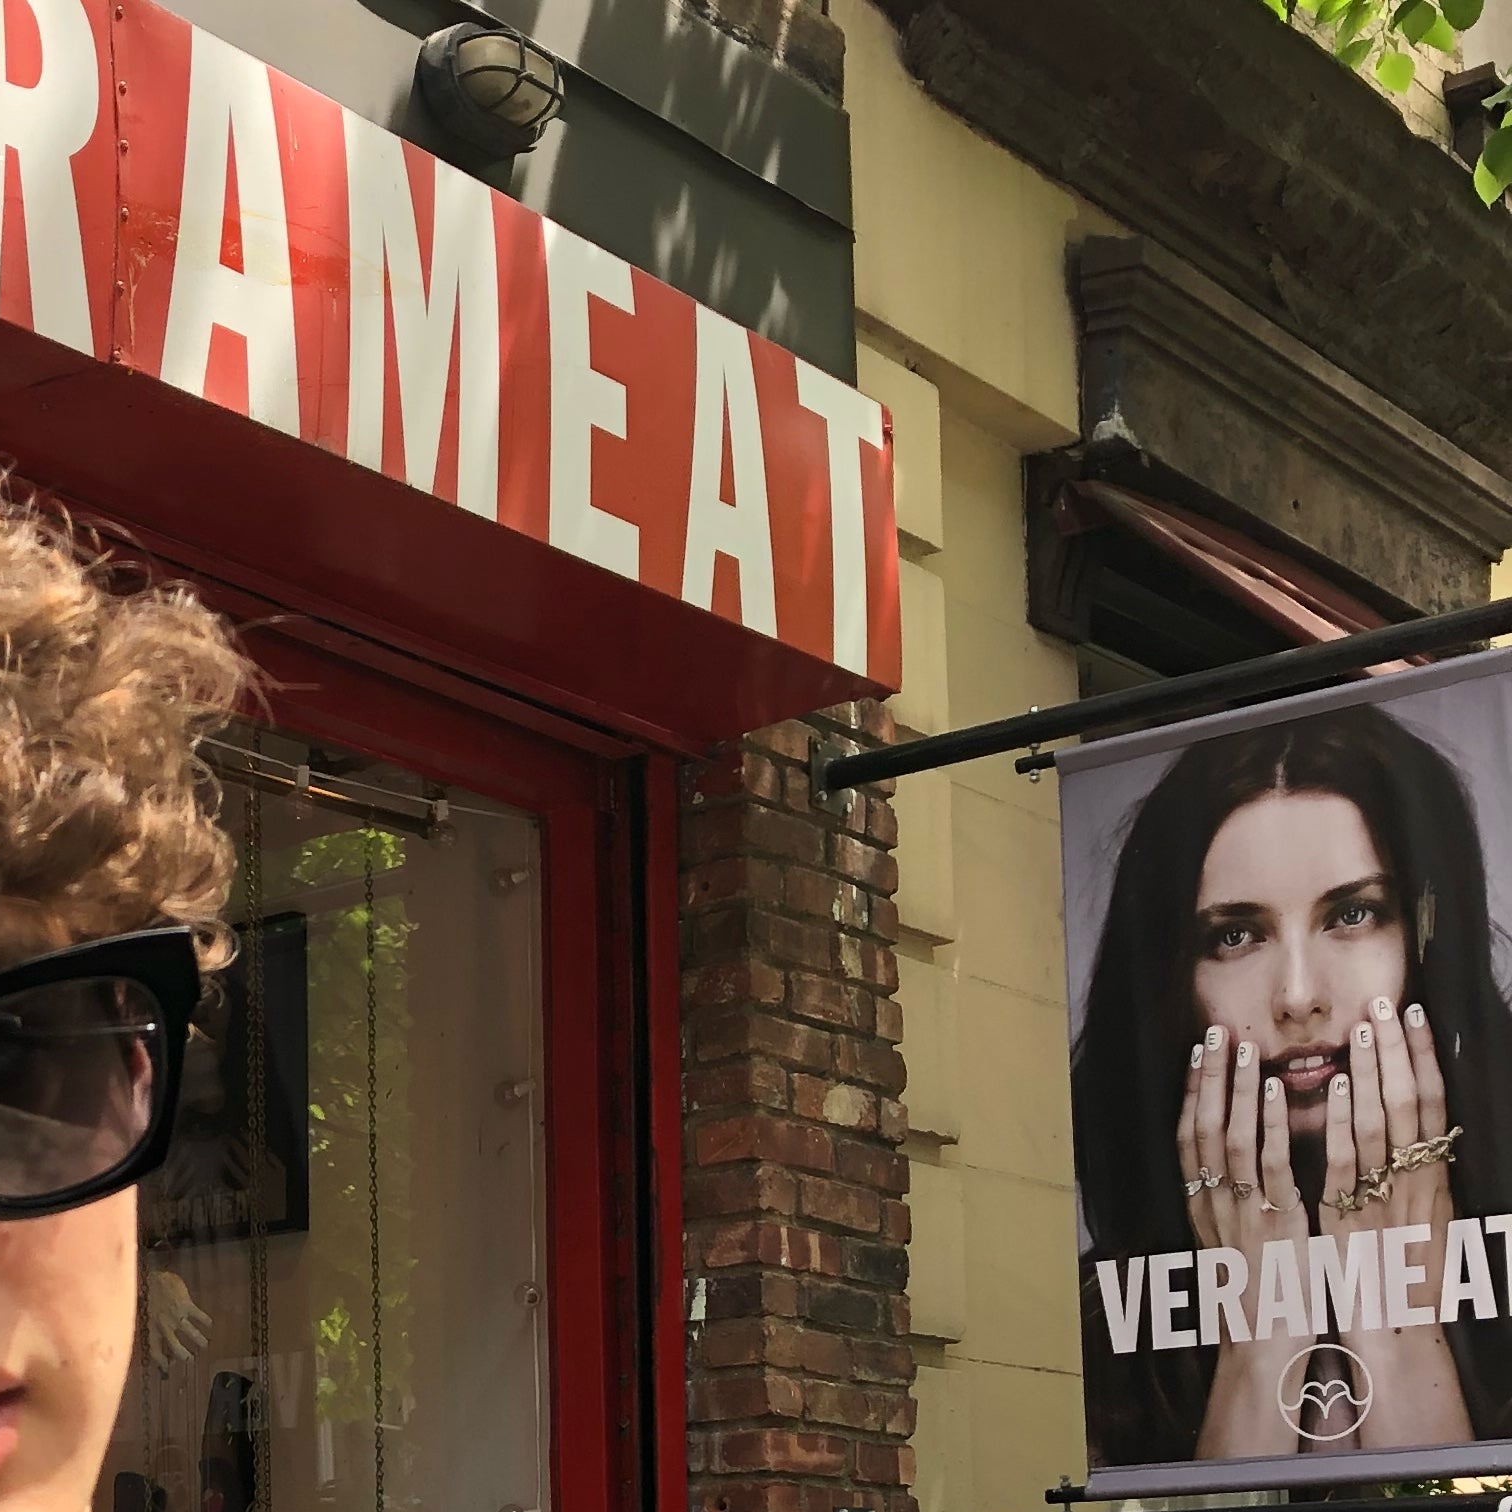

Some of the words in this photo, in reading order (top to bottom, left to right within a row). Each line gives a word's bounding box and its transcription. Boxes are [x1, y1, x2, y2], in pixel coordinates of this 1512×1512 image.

[1207, 1032, 1217, 1046] E
[1266, 1083, 1274, 1094] A
[1336, 1080, 1347, 1091] M
[1360, 1030, 1369, 1043] E
[1378, 1000, 1388, 1014] A
[1411, 1008, 1422, 1023] T
